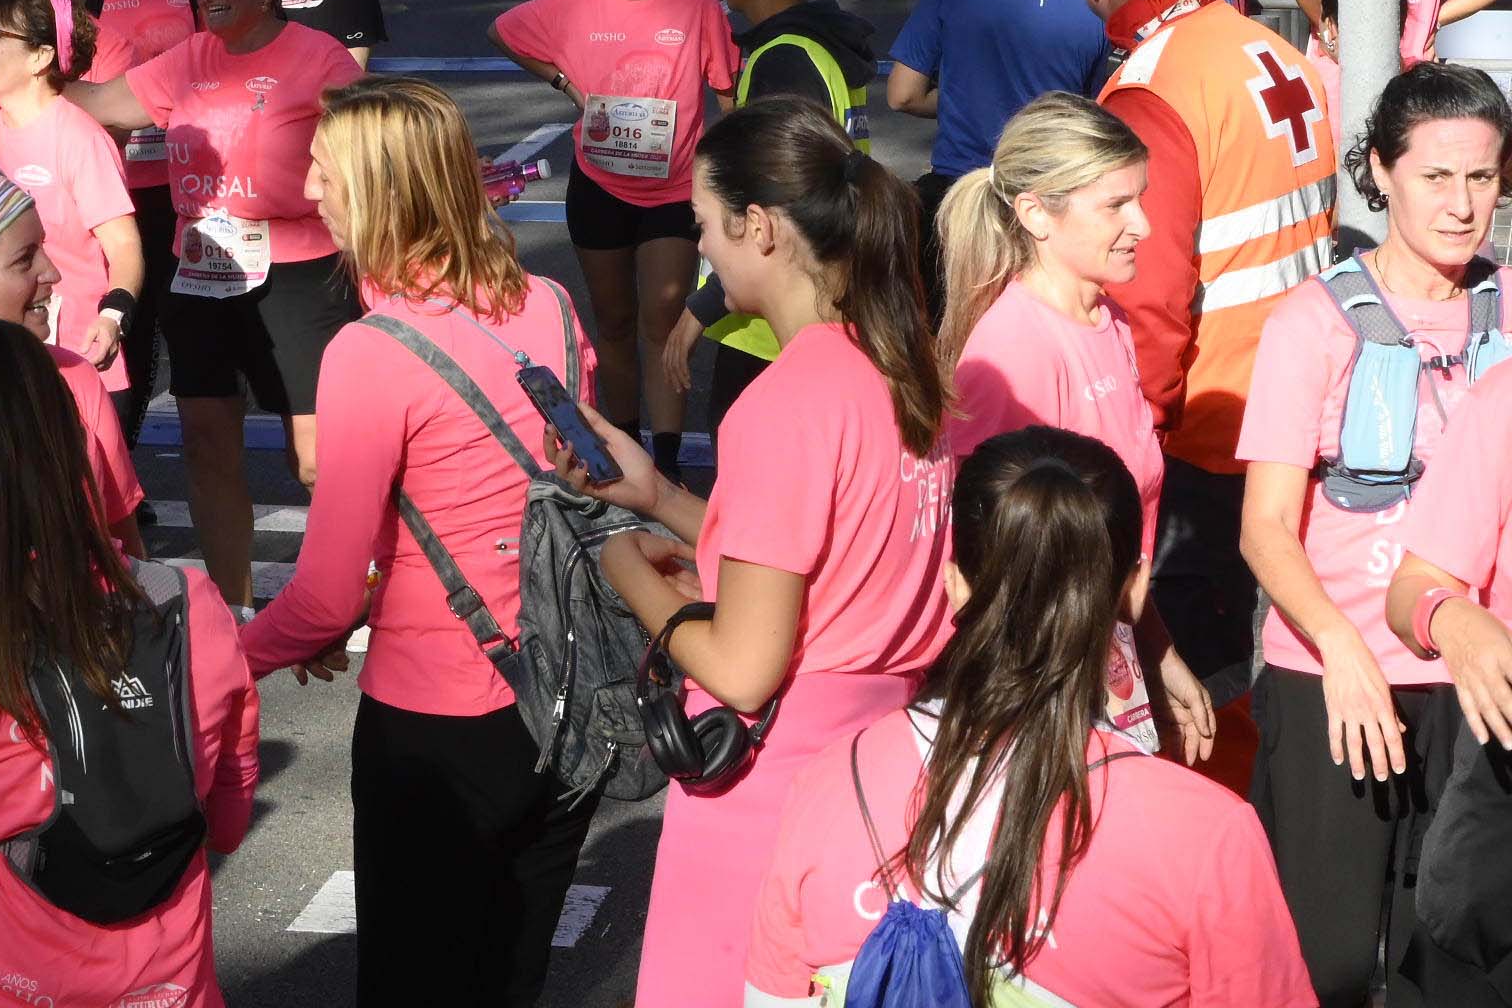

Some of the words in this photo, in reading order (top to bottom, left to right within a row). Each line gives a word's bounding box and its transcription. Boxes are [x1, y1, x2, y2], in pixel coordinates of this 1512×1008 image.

[589, 31, 626, 42] OYSHO
[612, 125, 642, 139] 016
[614, 140, 638, 150] 18814
[204, 245, 234, 260] 016
[208, 261, 232, 272] 19754
[1, 973, 40, 993] AÑOS
